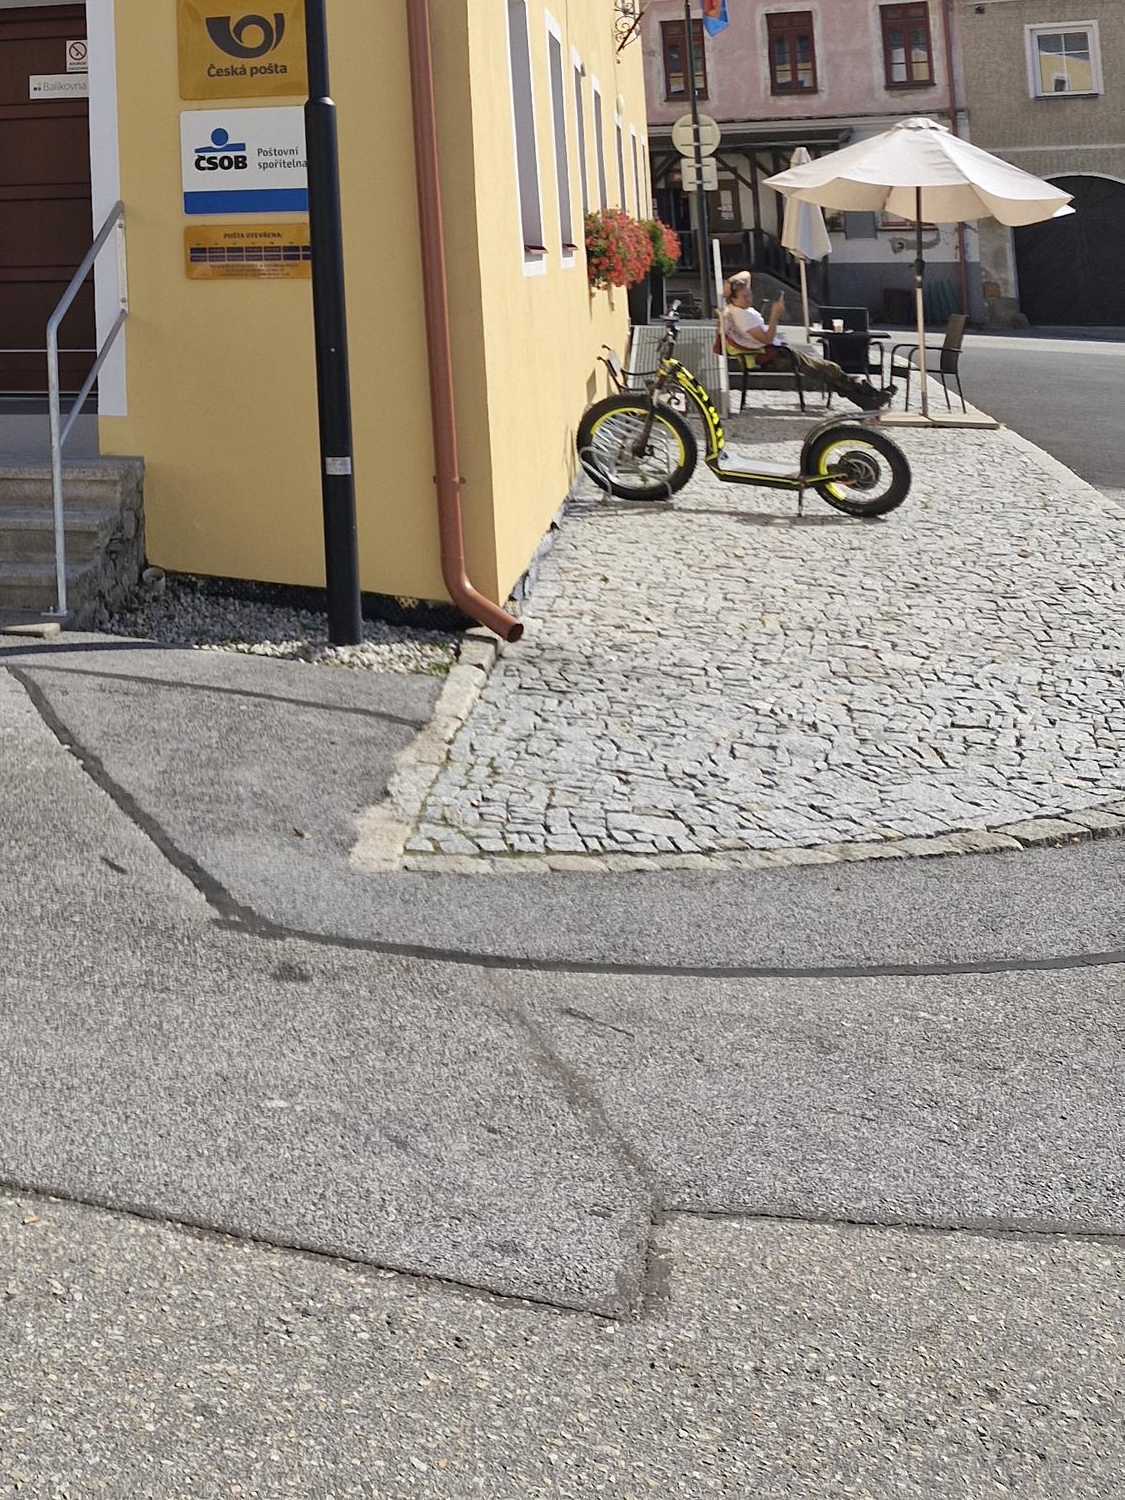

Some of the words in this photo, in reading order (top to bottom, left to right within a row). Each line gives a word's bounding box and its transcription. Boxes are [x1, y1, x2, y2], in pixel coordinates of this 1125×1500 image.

[207, 64, 247, 77] Česká
[250, 63, 288, 77] pošta
[257, 146, 299, 157] Poštovní
[194, 154, 248, 171] ČSOB
